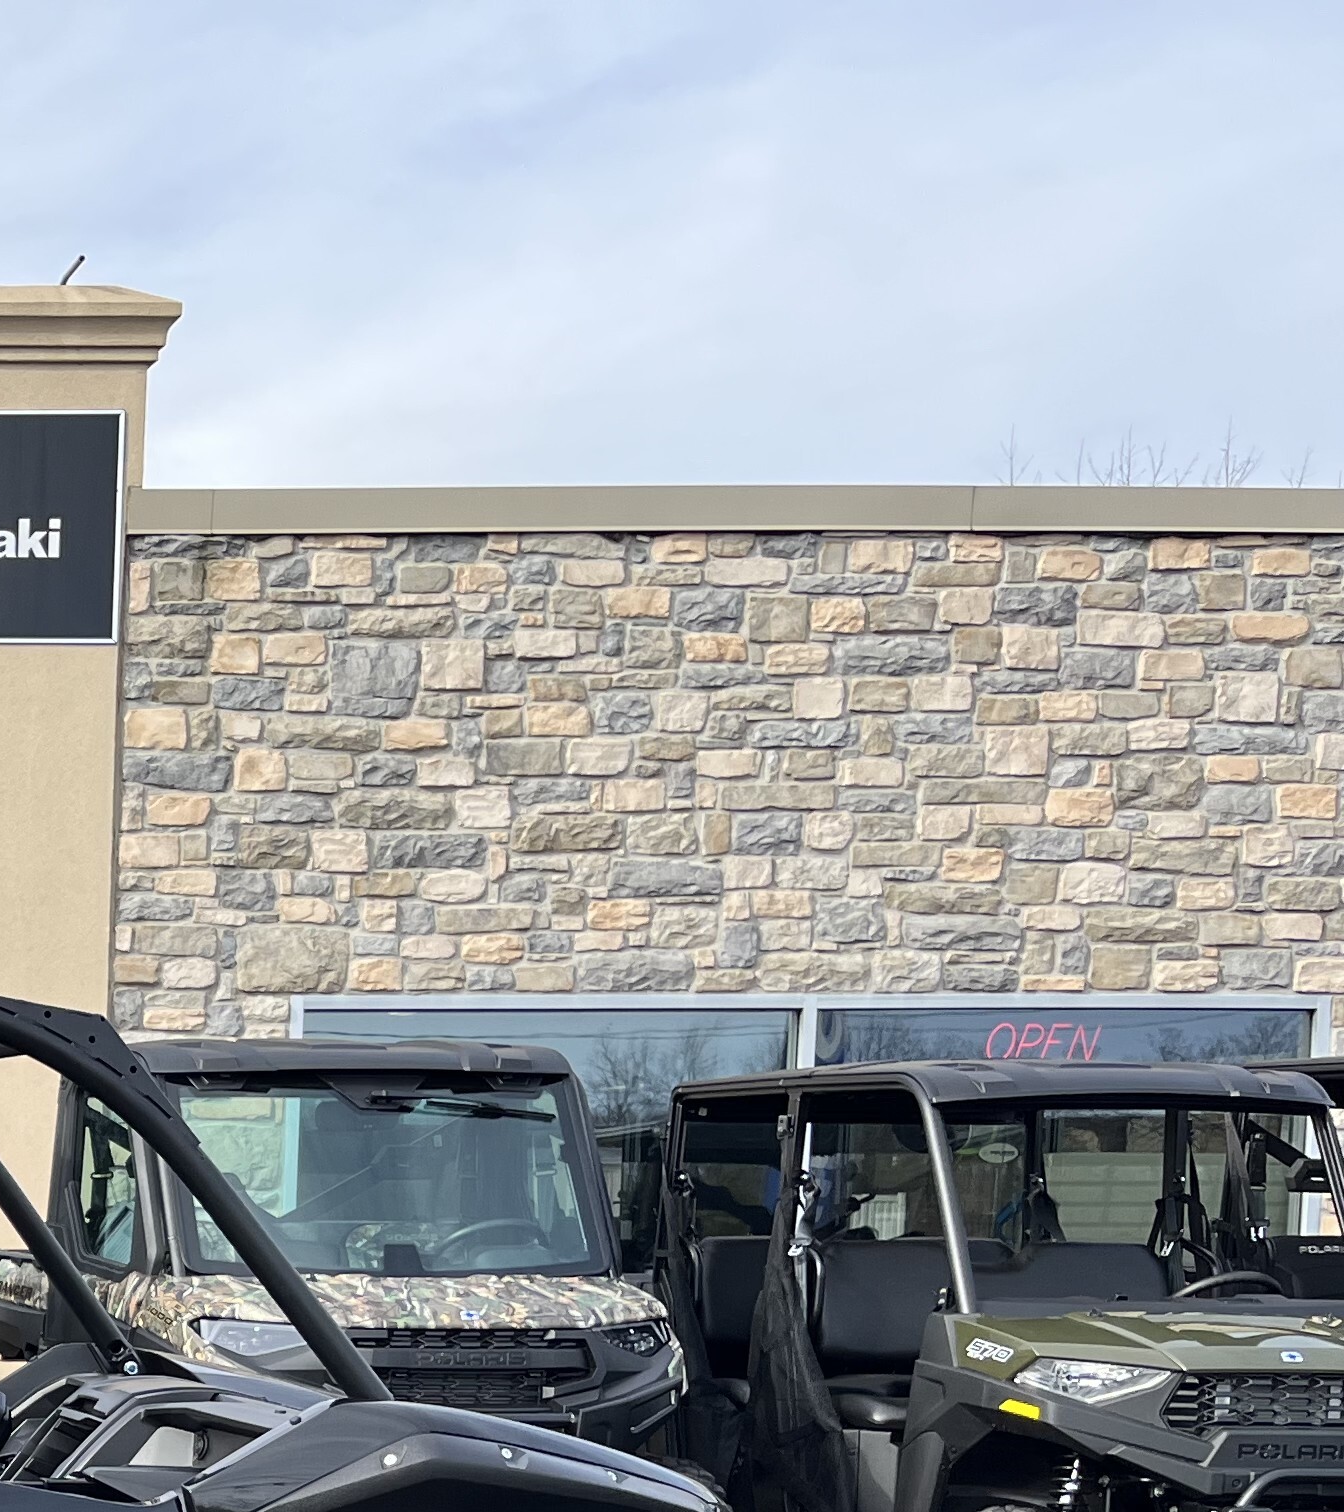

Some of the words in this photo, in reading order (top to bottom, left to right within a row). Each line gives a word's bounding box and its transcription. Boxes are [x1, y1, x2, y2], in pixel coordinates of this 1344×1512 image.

[986, 1022, 1103, 1061] OPEN
[416, 1352, 527, 1367] POLARIS
[966, 1337, 1014, 1362] 570
